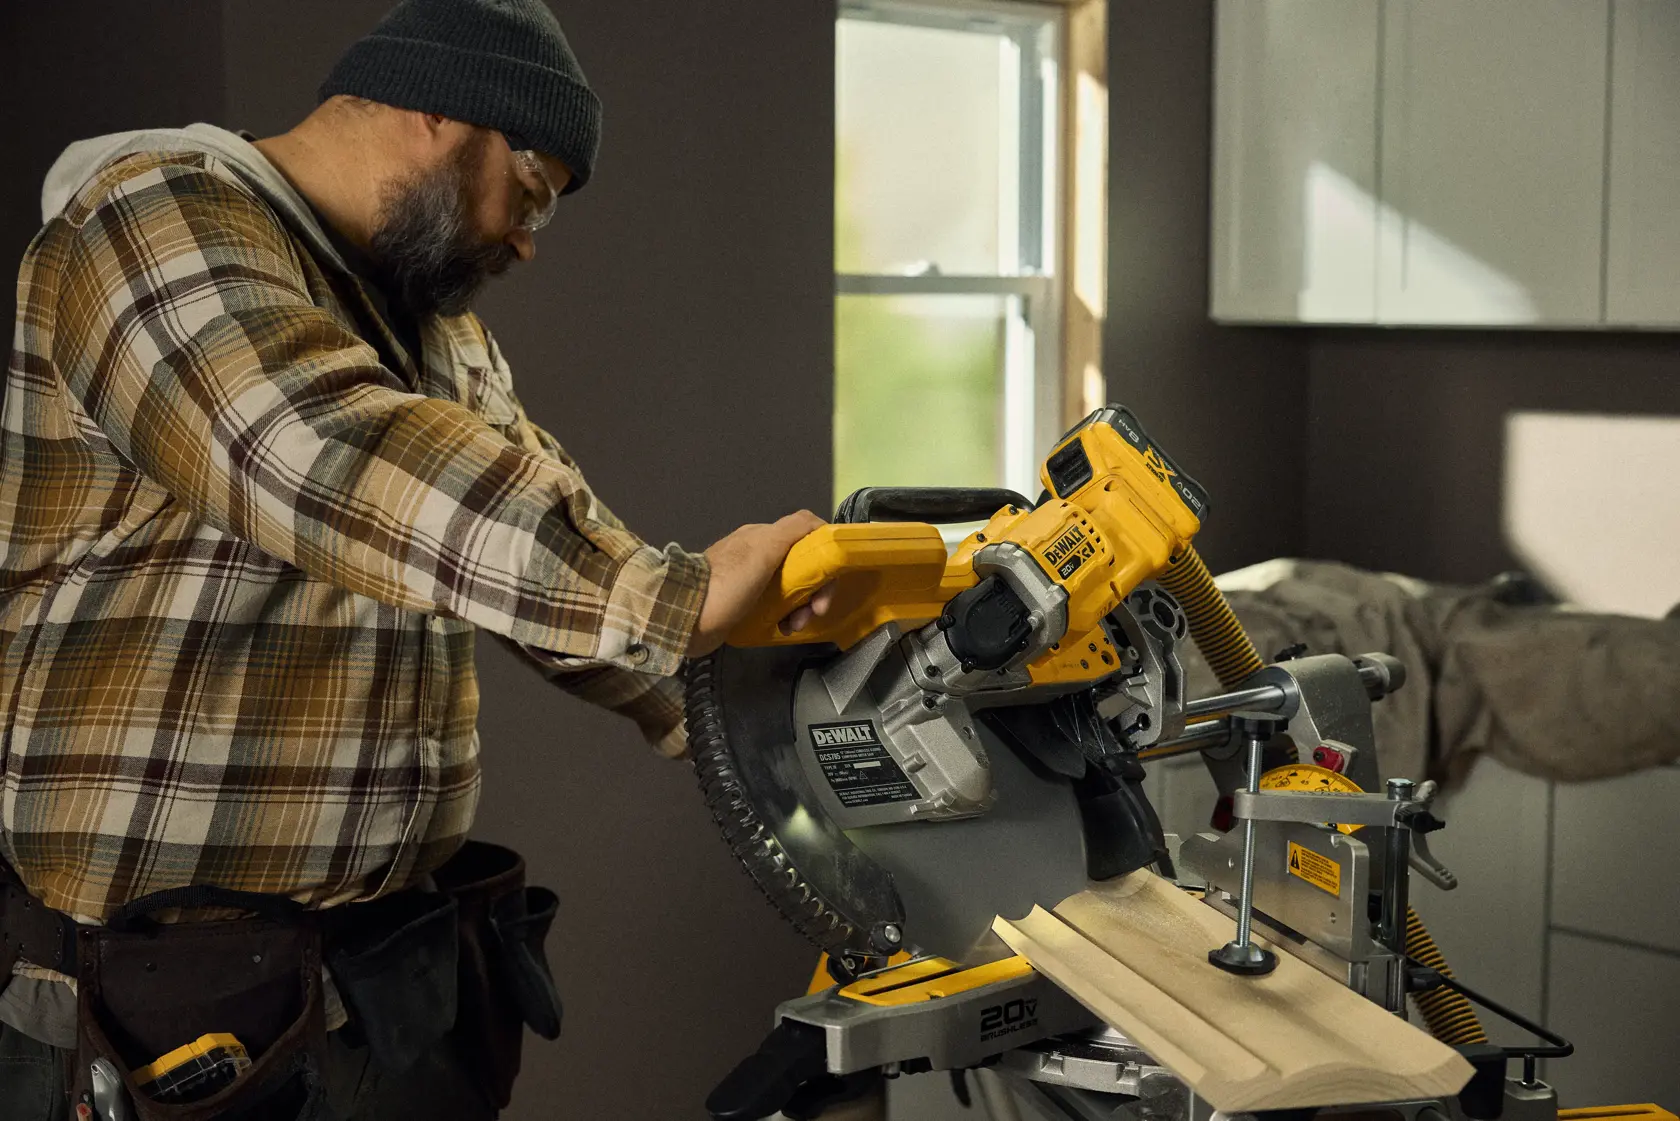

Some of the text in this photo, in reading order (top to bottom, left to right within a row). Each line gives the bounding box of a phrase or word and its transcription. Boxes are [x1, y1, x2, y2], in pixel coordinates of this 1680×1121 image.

[1143, 445, 1177, 478] XR
[1044, 525, 1086, 565] DEWALT
[812, 727, 872, 744] DEWALT
